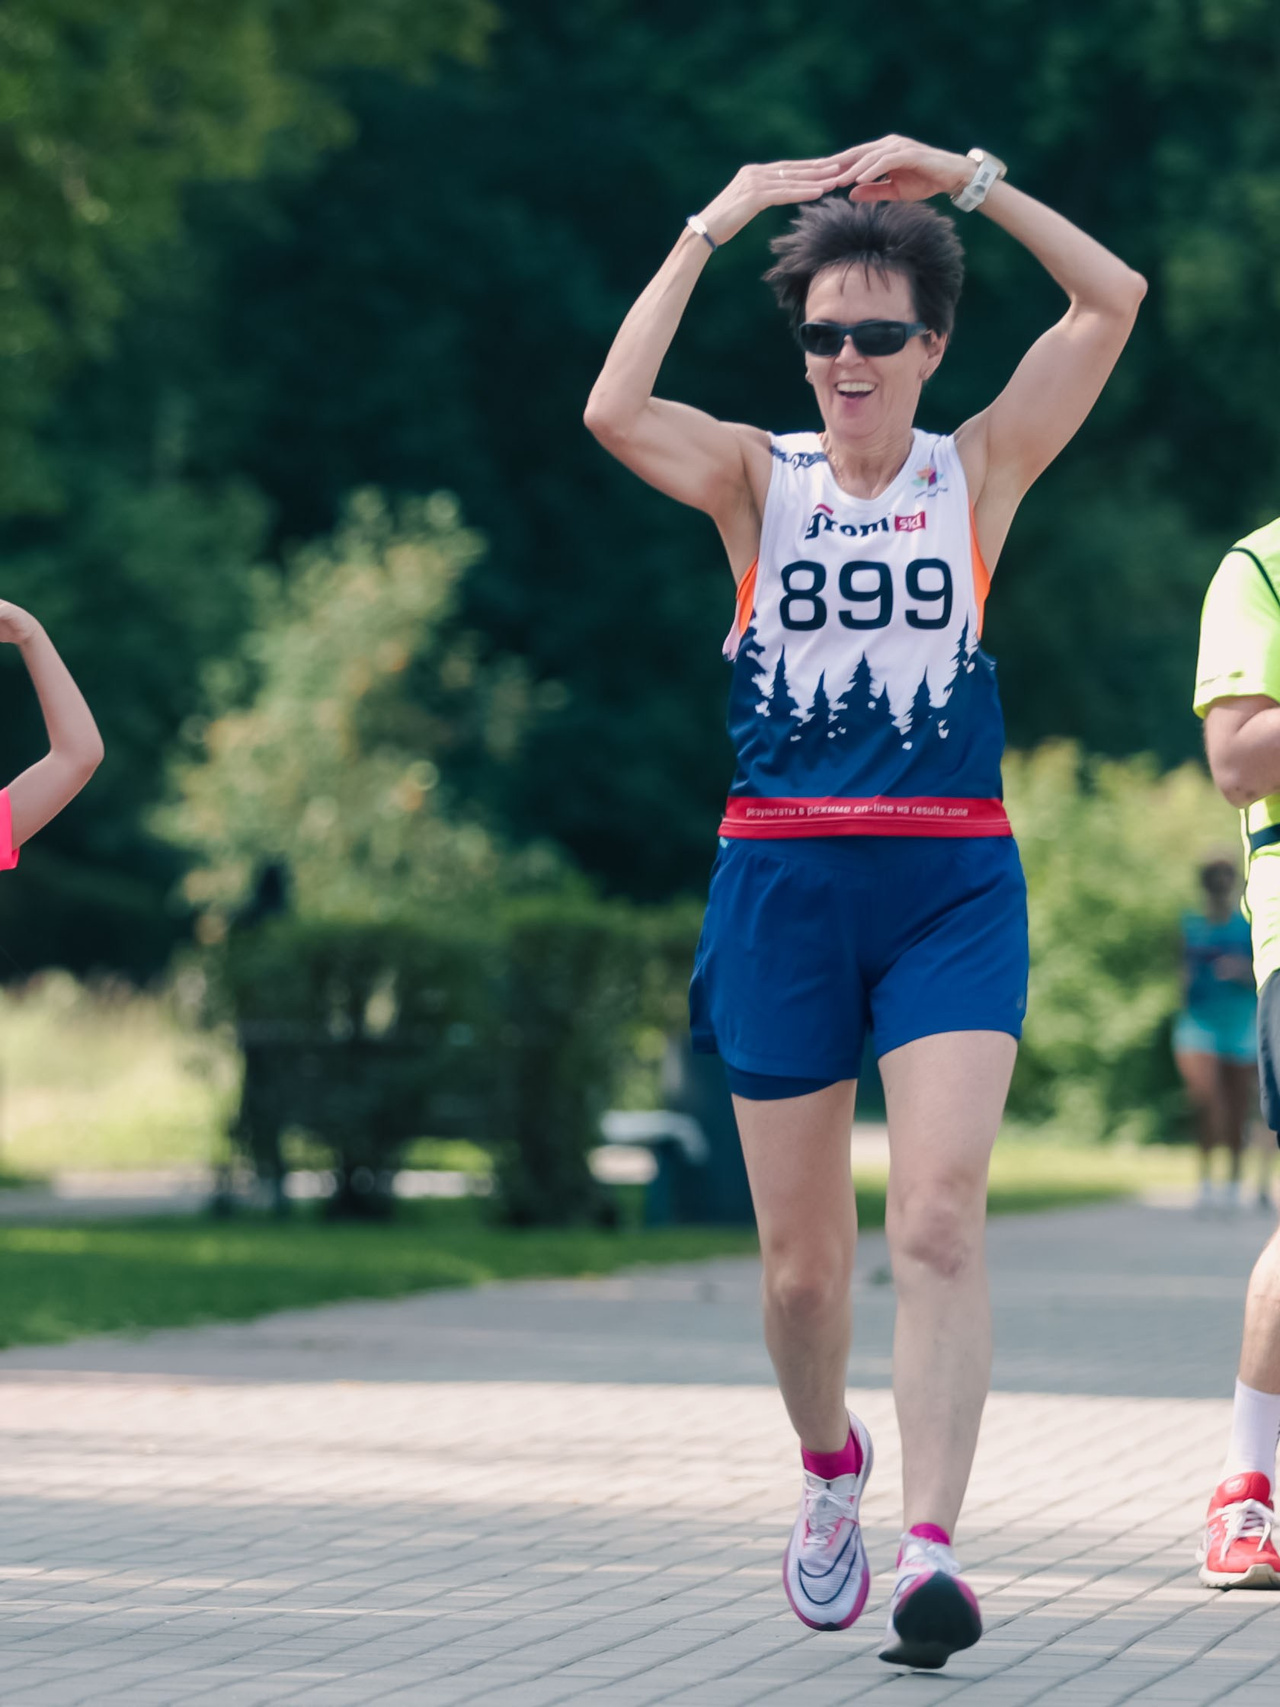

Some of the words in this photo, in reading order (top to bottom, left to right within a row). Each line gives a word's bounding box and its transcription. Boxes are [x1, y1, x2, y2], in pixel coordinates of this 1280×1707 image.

[779, 558, 953, 631] 899
[807, 805, 851, 817] режиме
[853, 803, 894, 814] on-line
[896, 805, 910, 814] на
